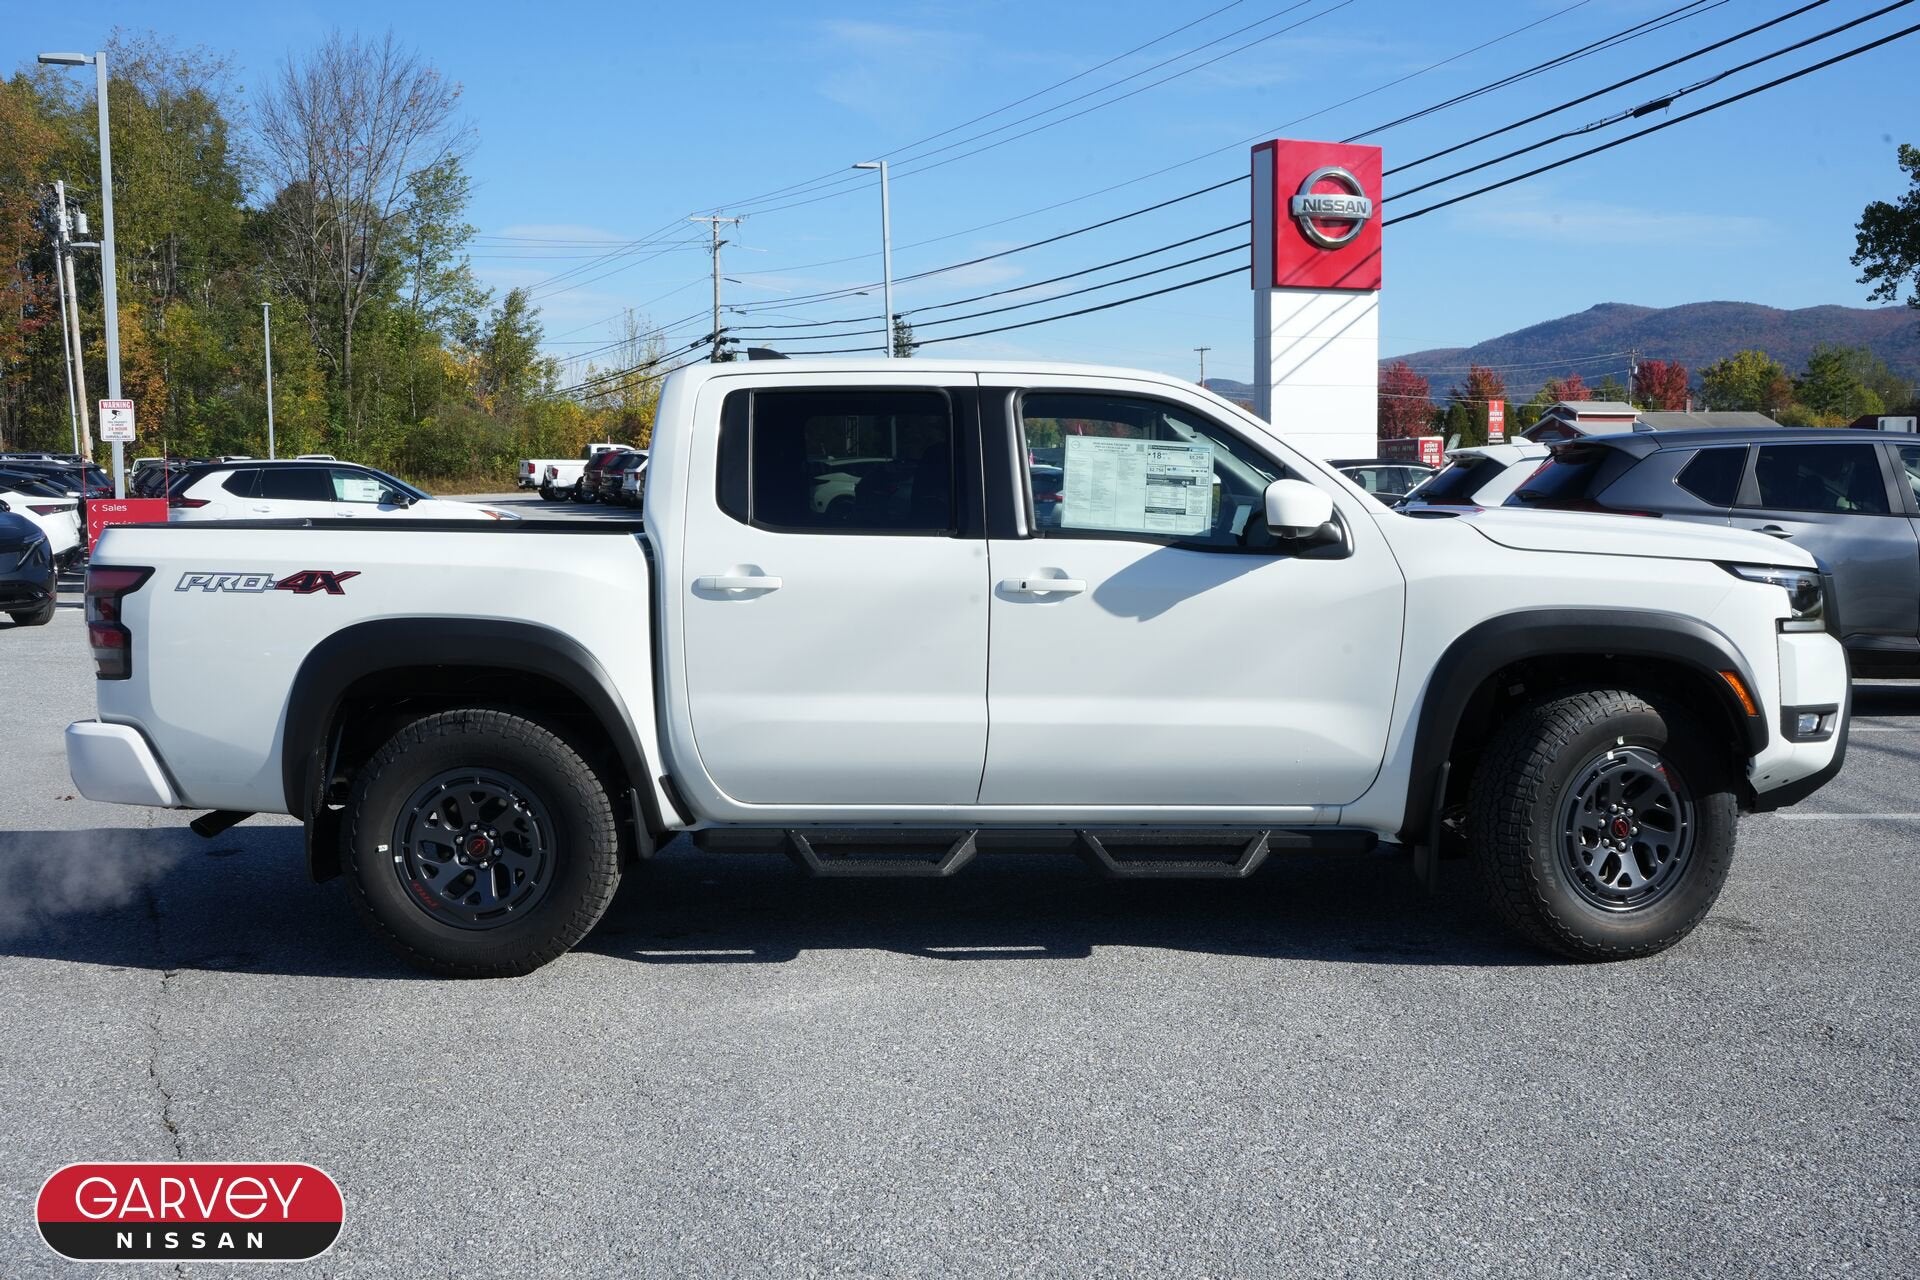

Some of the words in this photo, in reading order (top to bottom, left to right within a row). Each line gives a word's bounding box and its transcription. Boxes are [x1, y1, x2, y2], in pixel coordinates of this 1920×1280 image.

[1302, 198, 1367, 214] NISSAN
[102, 401, 131, 409] WARNING
[102, 504, 127, 512] Sales
[174, 570, 361, 595] PRO-4X
